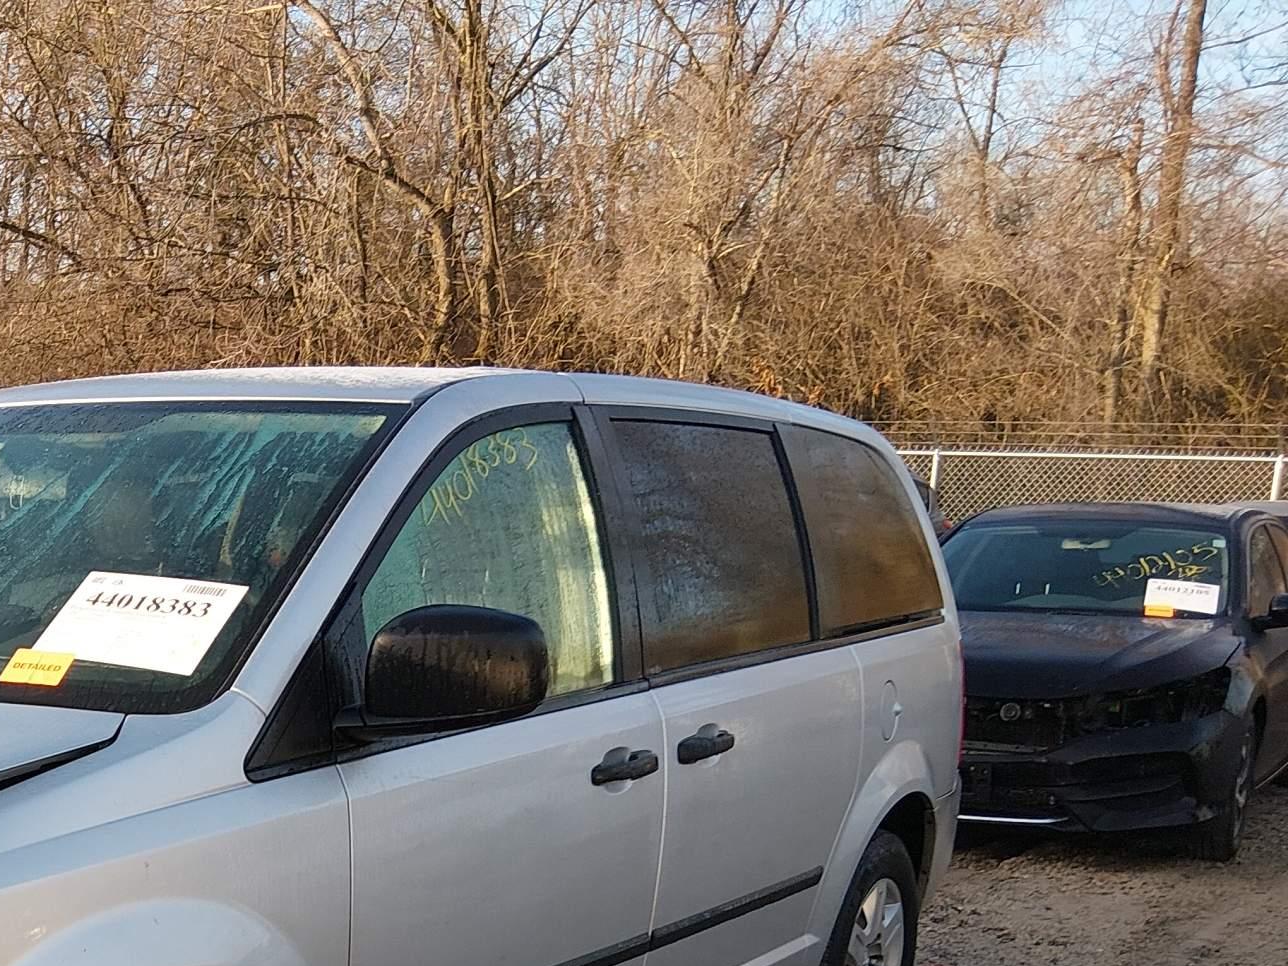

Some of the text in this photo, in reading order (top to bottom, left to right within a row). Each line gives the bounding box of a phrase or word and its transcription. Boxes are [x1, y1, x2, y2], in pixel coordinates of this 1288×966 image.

[421, 427, 539, 526] 44018383
[85, 591, 213, 618] 44018383
[12, 660, 63, 673] DETAILED
